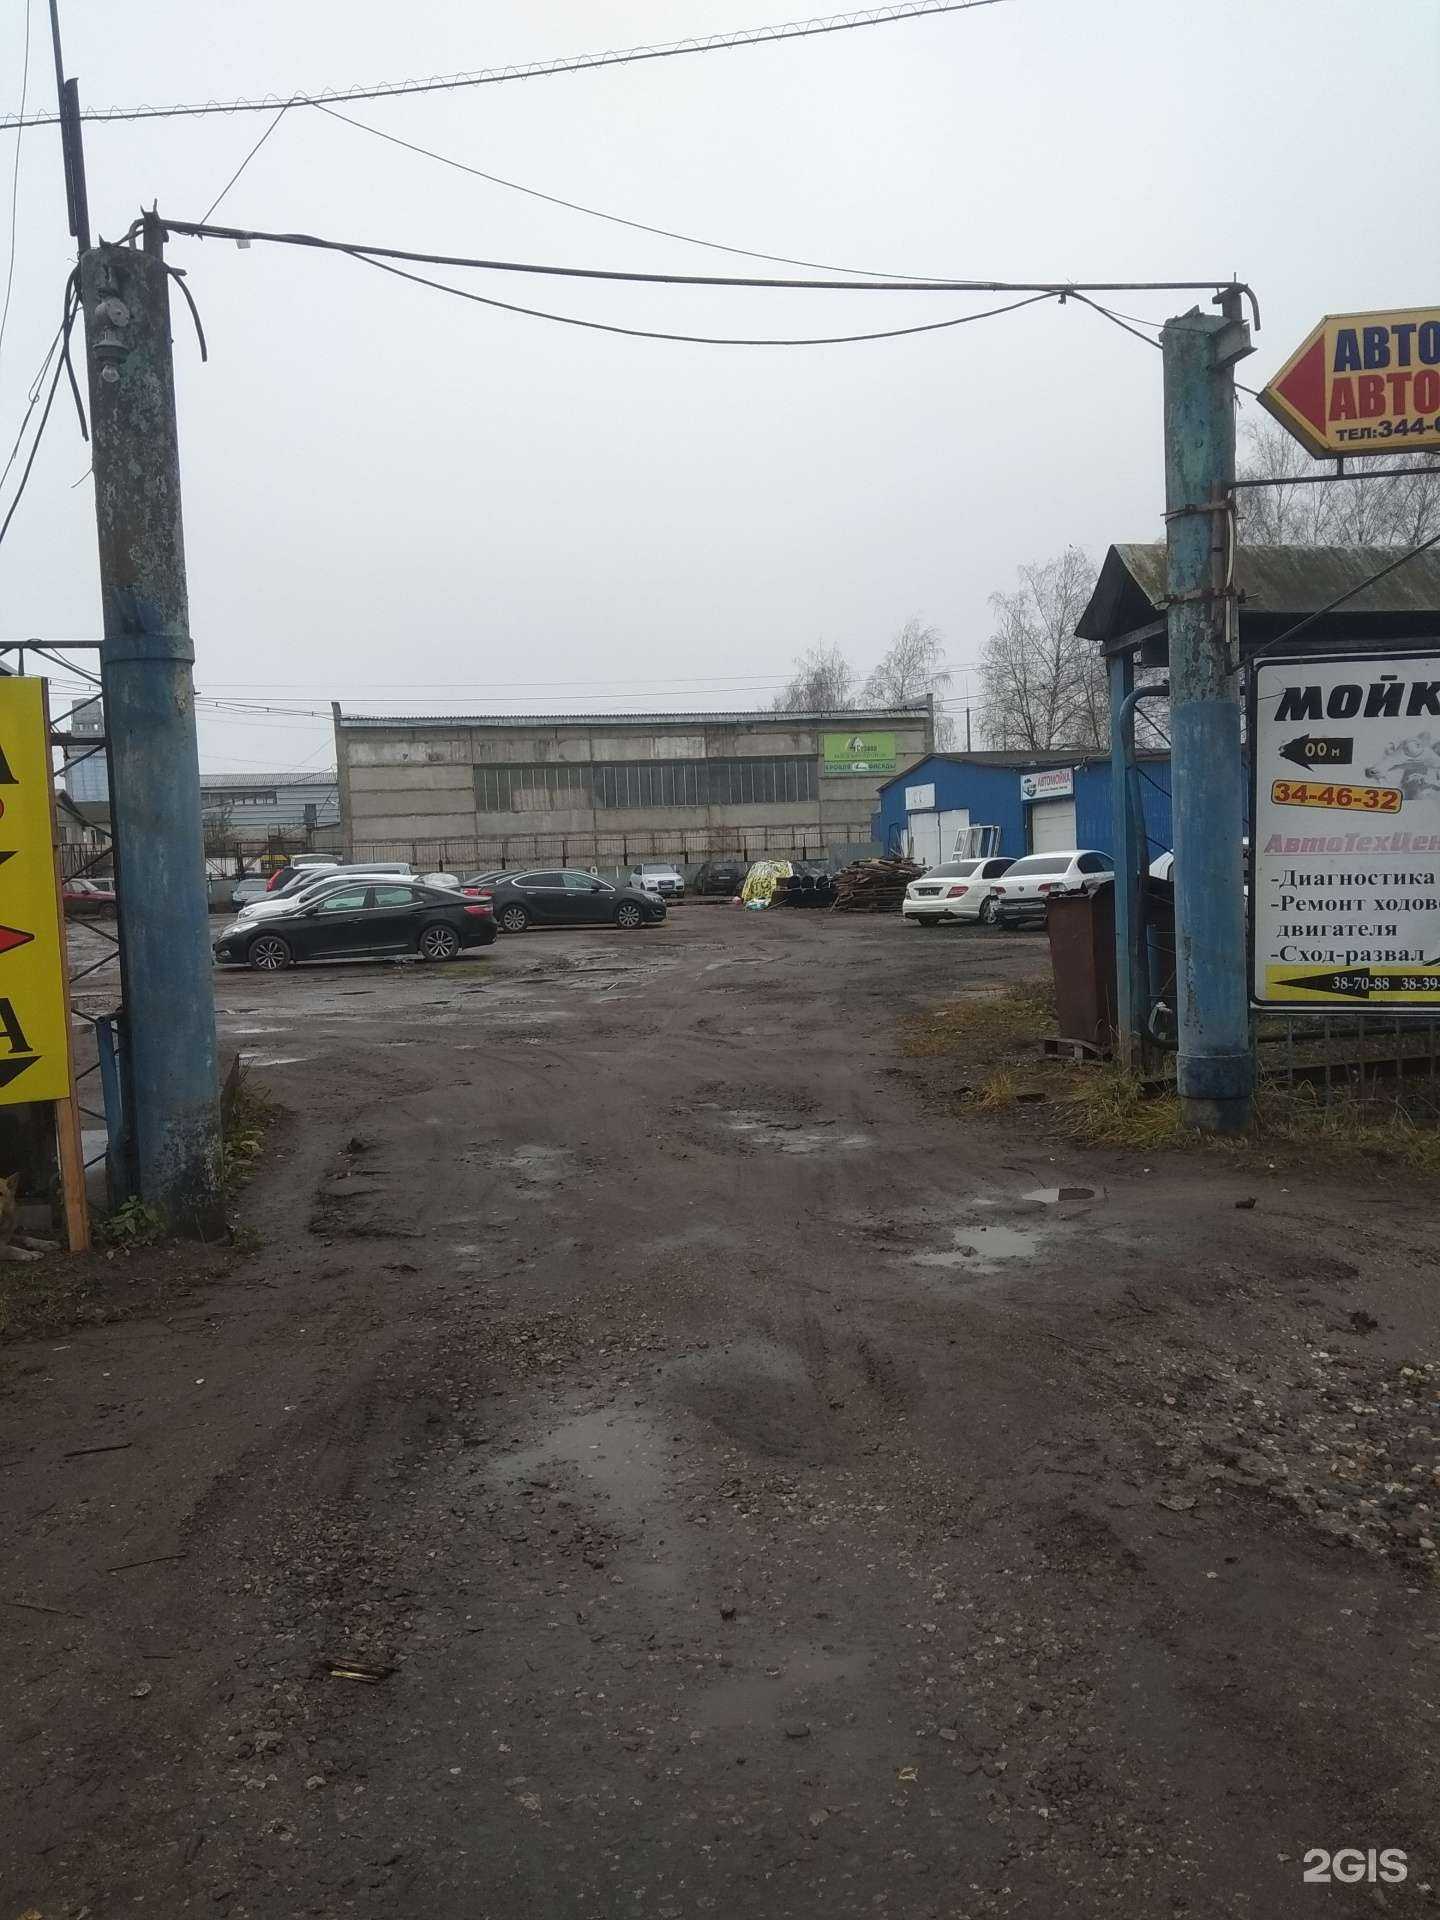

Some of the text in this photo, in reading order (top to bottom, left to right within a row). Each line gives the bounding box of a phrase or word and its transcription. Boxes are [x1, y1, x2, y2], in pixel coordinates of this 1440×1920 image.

[1328, 369, 1440, 421] АВТО
[1274, 783, 1399, 811] 34-46-32
[1374, 898, 1440, 912] ходов
[1276, 924, 1399, 938] двигателя
[1331, 976, 1390, 991] 38-70-88
